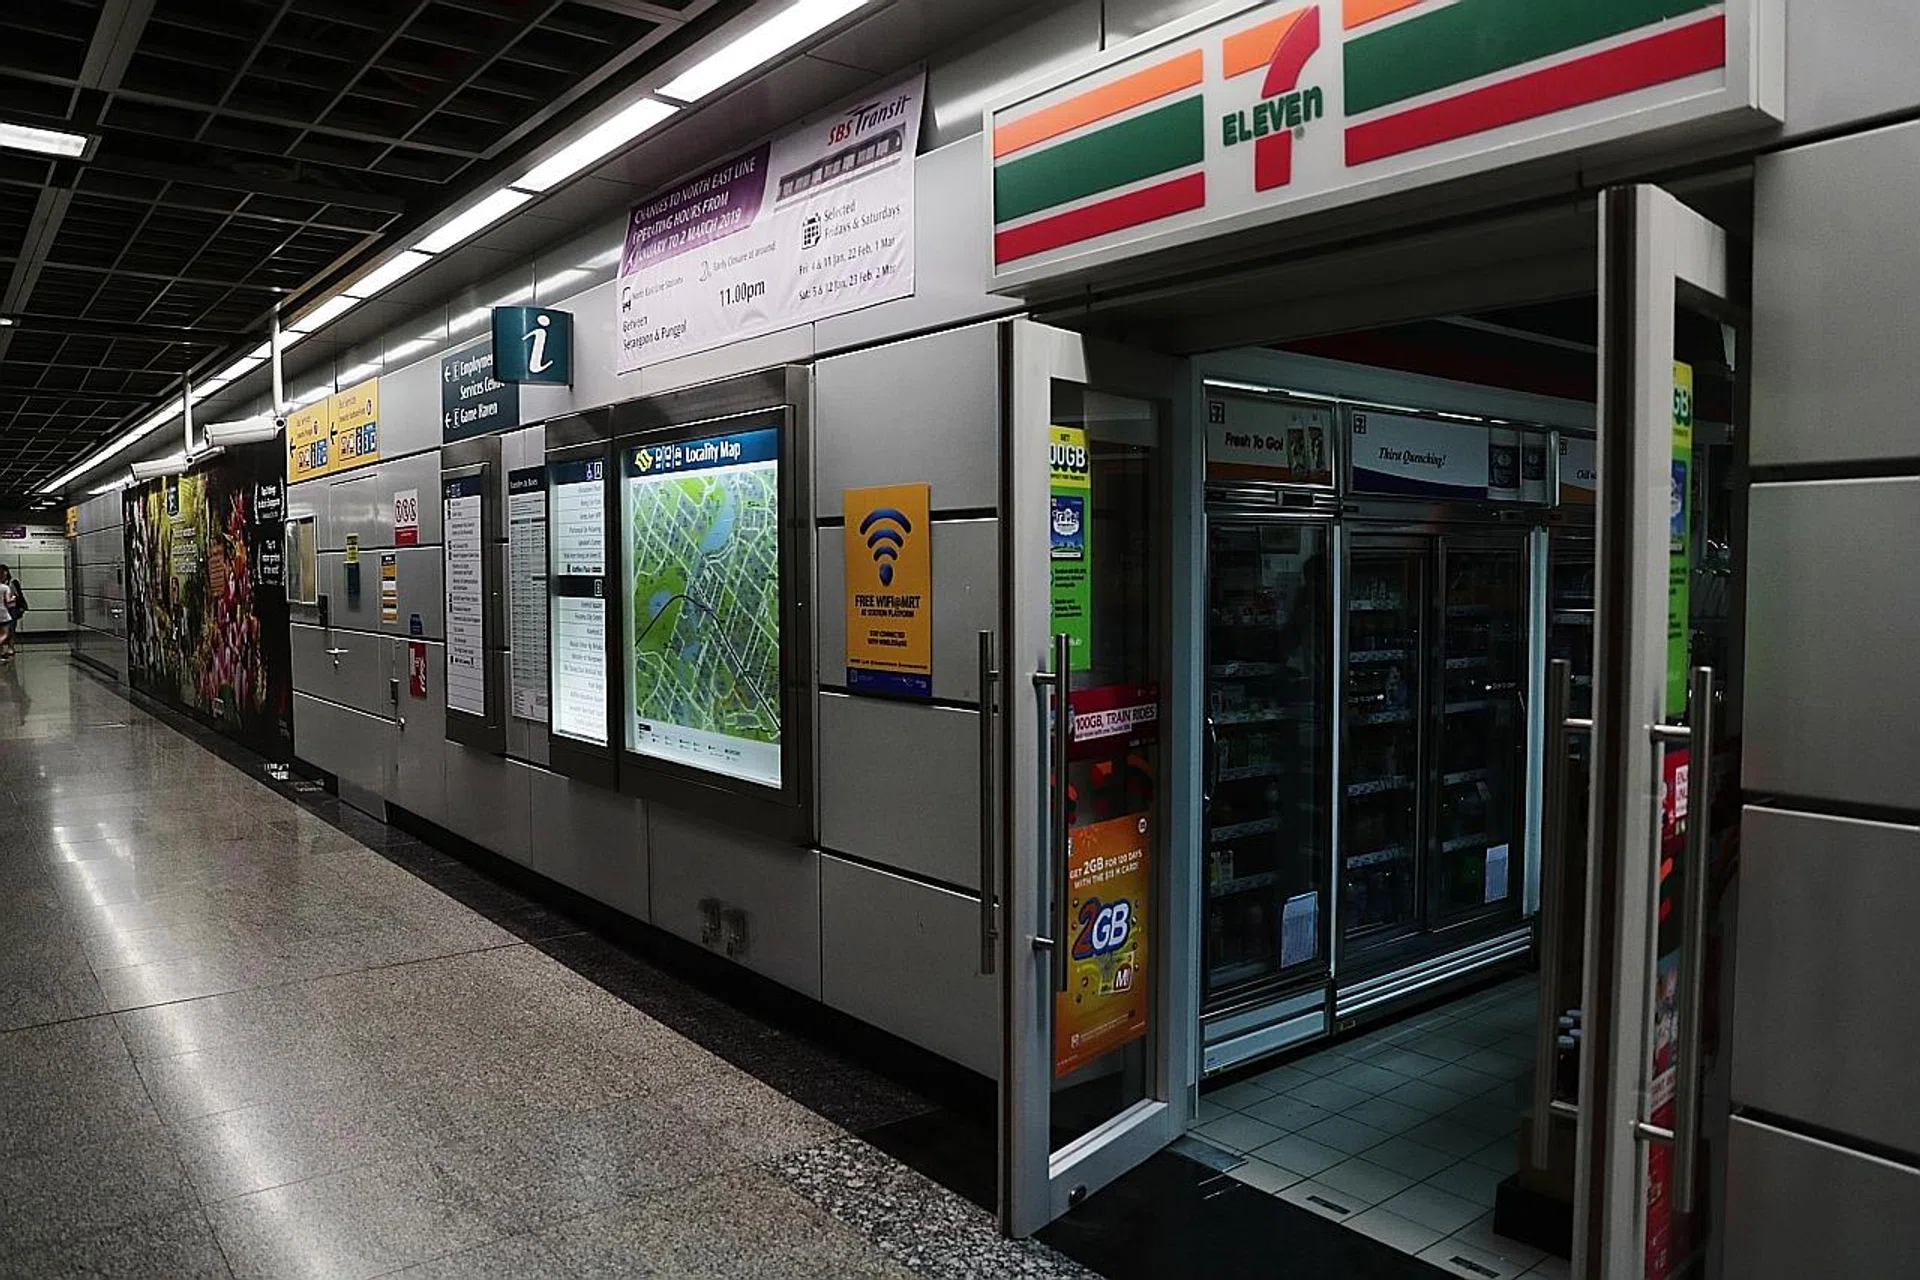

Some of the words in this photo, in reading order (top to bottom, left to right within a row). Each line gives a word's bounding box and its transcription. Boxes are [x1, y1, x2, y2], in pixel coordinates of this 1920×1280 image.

[1256, 5, 1320, 192] 7
[828, 119, 853, 146] SBS
[850, 95, 912, 137] Transit
[668, 191, 681, 208] TO
[681, 178, 712, 203] NORTH
[711, 167, 733, 189] EAST
[734, 155, 757, 179] LINE
[702, 191, 730, 215] FROM
[861, 204, 901, 227] Saturdays
[680, 230, 687, 246] 2
[687, 218, 719, 244] MARCH
[719, 207, 743, 231] 2019
[719, 280, 766, 308] 11.00pm
[522, 315, 553, 373] i
[460, 378, 484, 400] Services
[686, 442, 719, 463] Locality
[720, 441, 741, 459] Map
[1225, 432, 1250, 449] Fresh
[1252, 434, 1264, 449] To
[1265, 437, 1284, 451] Go!
[855, 594, 875, 607] FREE
[1105, 709, 1131, 725] TRAIN
[1083, 856, 1104, 876] 2GB
[1128, 848, 1143, 861] DAYS
[1072, 896, 1131, 960] 2GB
